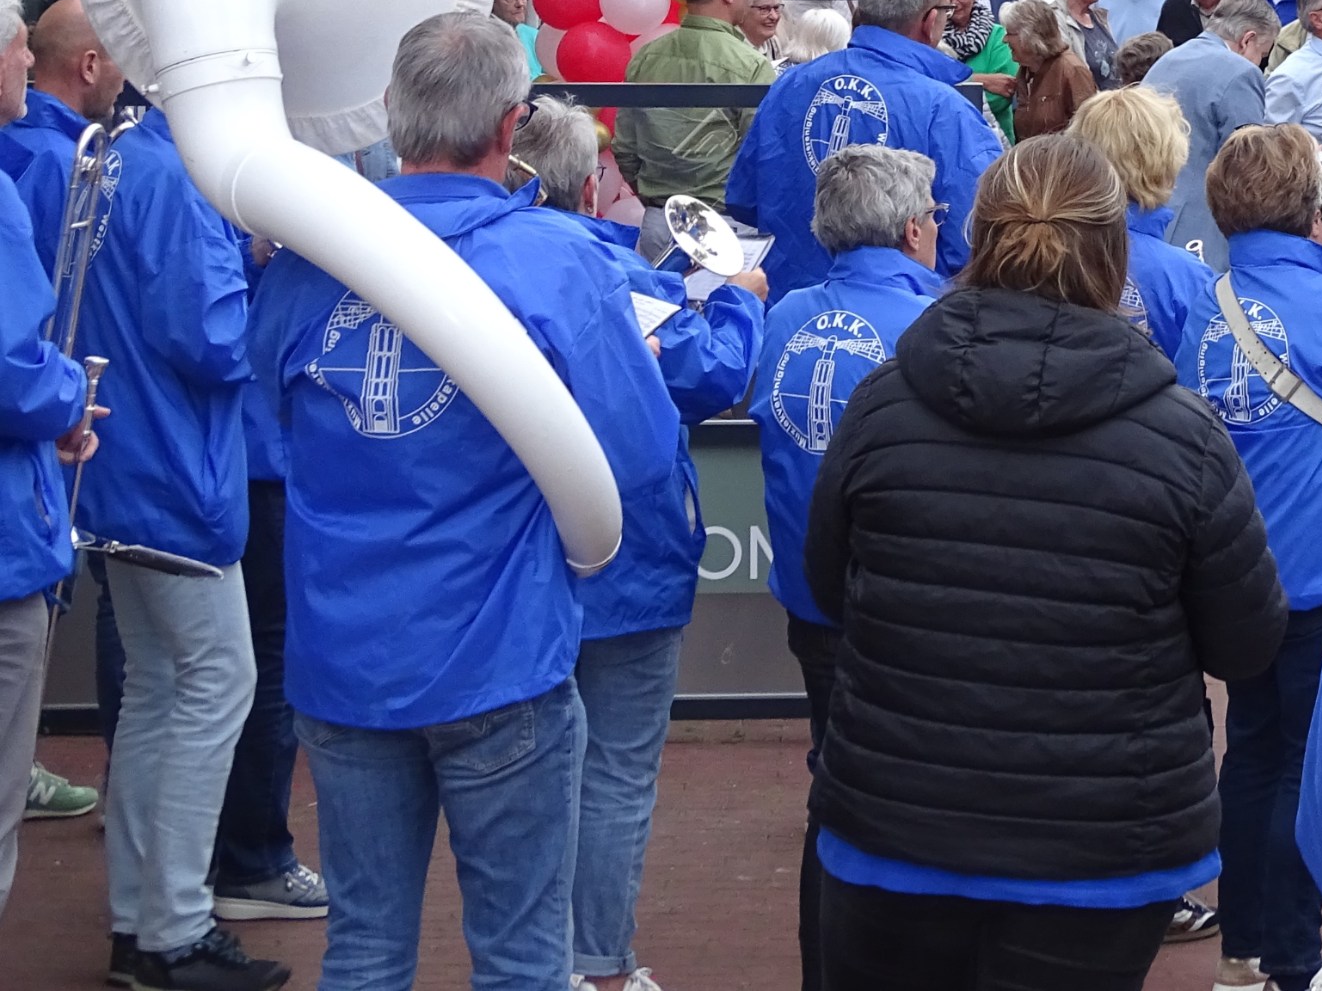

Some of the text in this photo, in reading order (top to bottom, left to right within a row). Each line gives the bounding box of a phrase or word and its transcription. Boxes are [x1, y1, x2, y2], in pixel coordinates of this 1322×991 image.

[834, 77, 874, 101] O.K.K.
[804, 106, 820, 173] ziekvereniging
[816, 312, 866, 338] O.K.K.
[772, 352, 808, 449] Muziekvereniging
